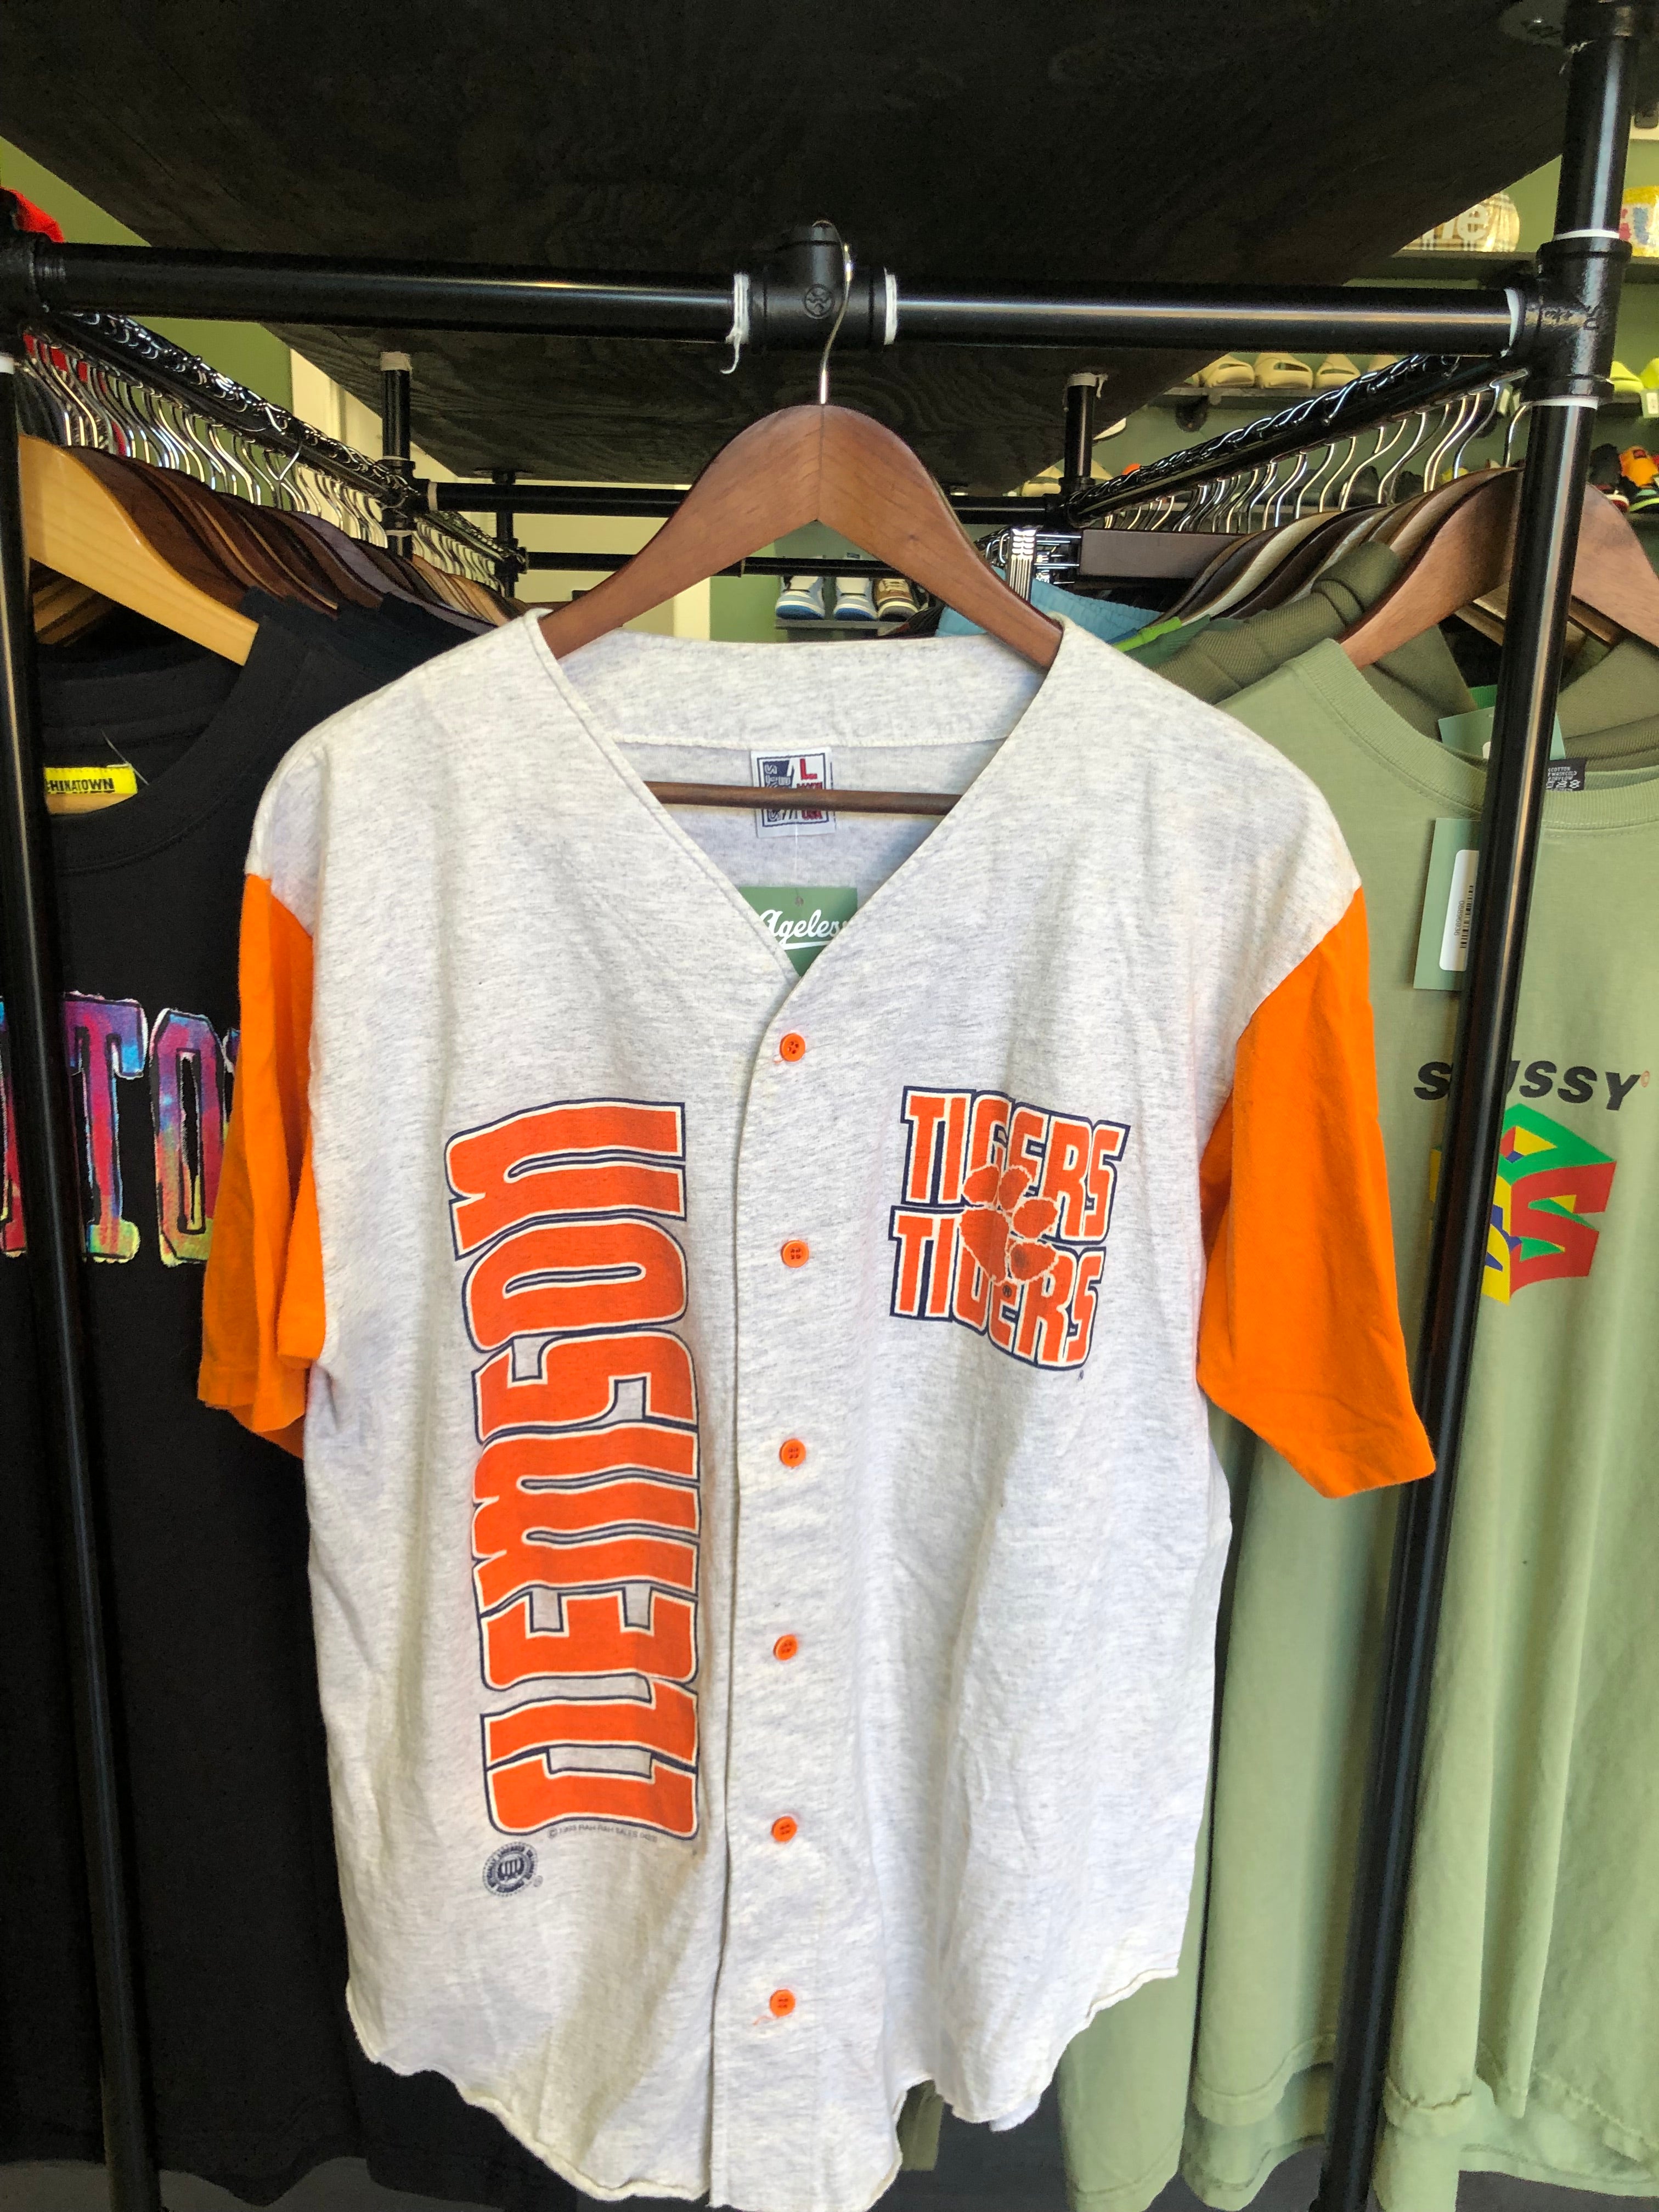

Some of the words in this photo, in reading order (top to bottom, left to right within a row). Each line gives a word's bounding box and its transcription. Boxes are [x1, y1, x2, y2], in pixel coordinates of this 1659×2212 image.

[800, 758, 817, 780] L
[1413, 1059, 1641, 1111] SSSY
[900, 1085, 1131, 1245] TIGERS
